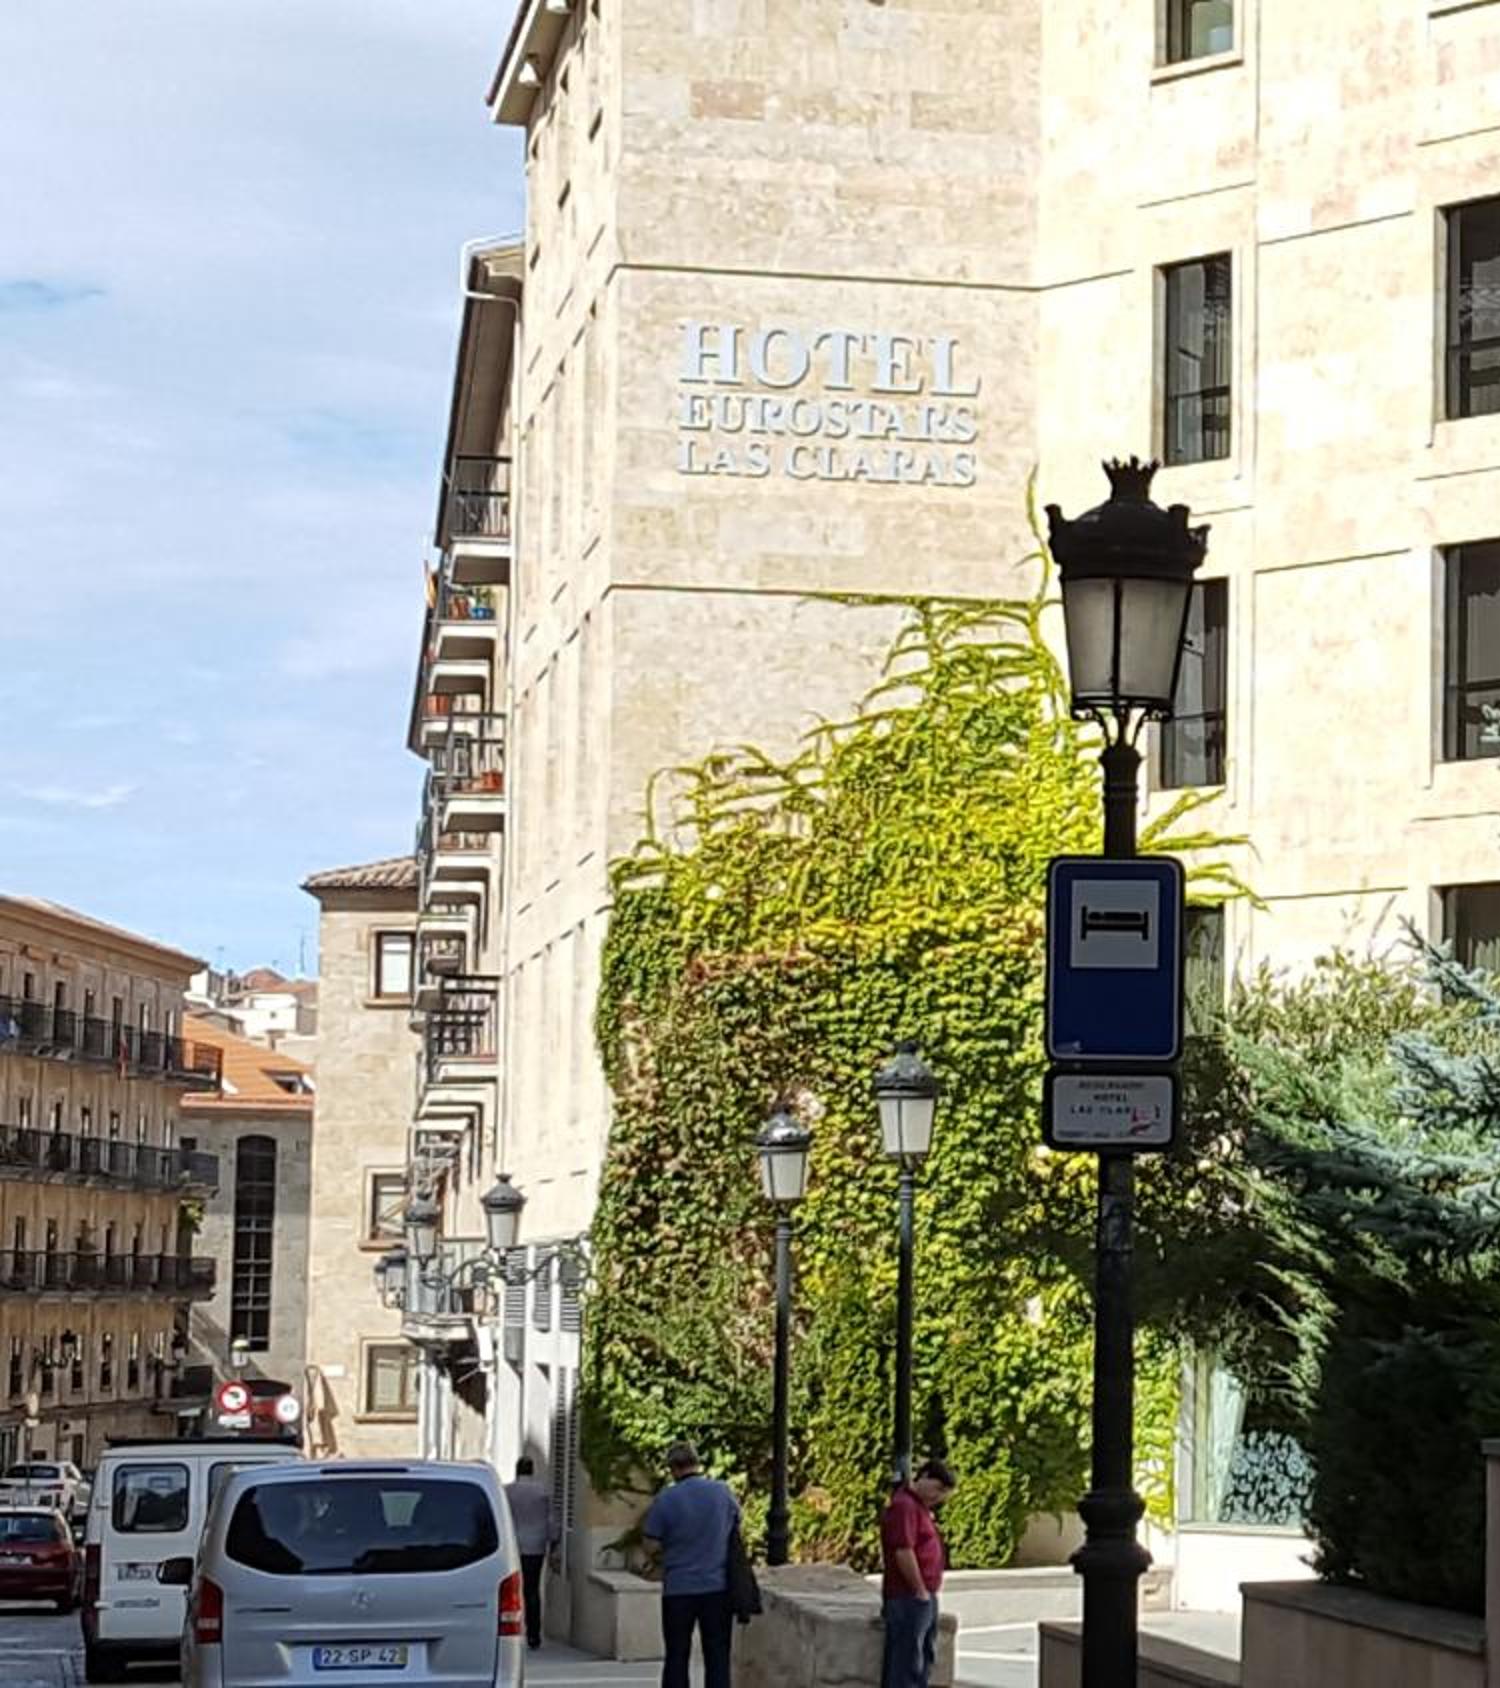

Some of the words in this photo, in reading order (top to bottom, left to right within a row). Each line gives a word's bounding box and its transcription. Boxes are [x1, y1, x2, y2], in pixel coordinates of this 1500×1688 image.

[679, 320, 981, 397] HOTEL
[678, 394, 979, 444] EUROSTARS
[677, 440, 771, 478] LAS
[785, 446, 978, 488] CLARAS
